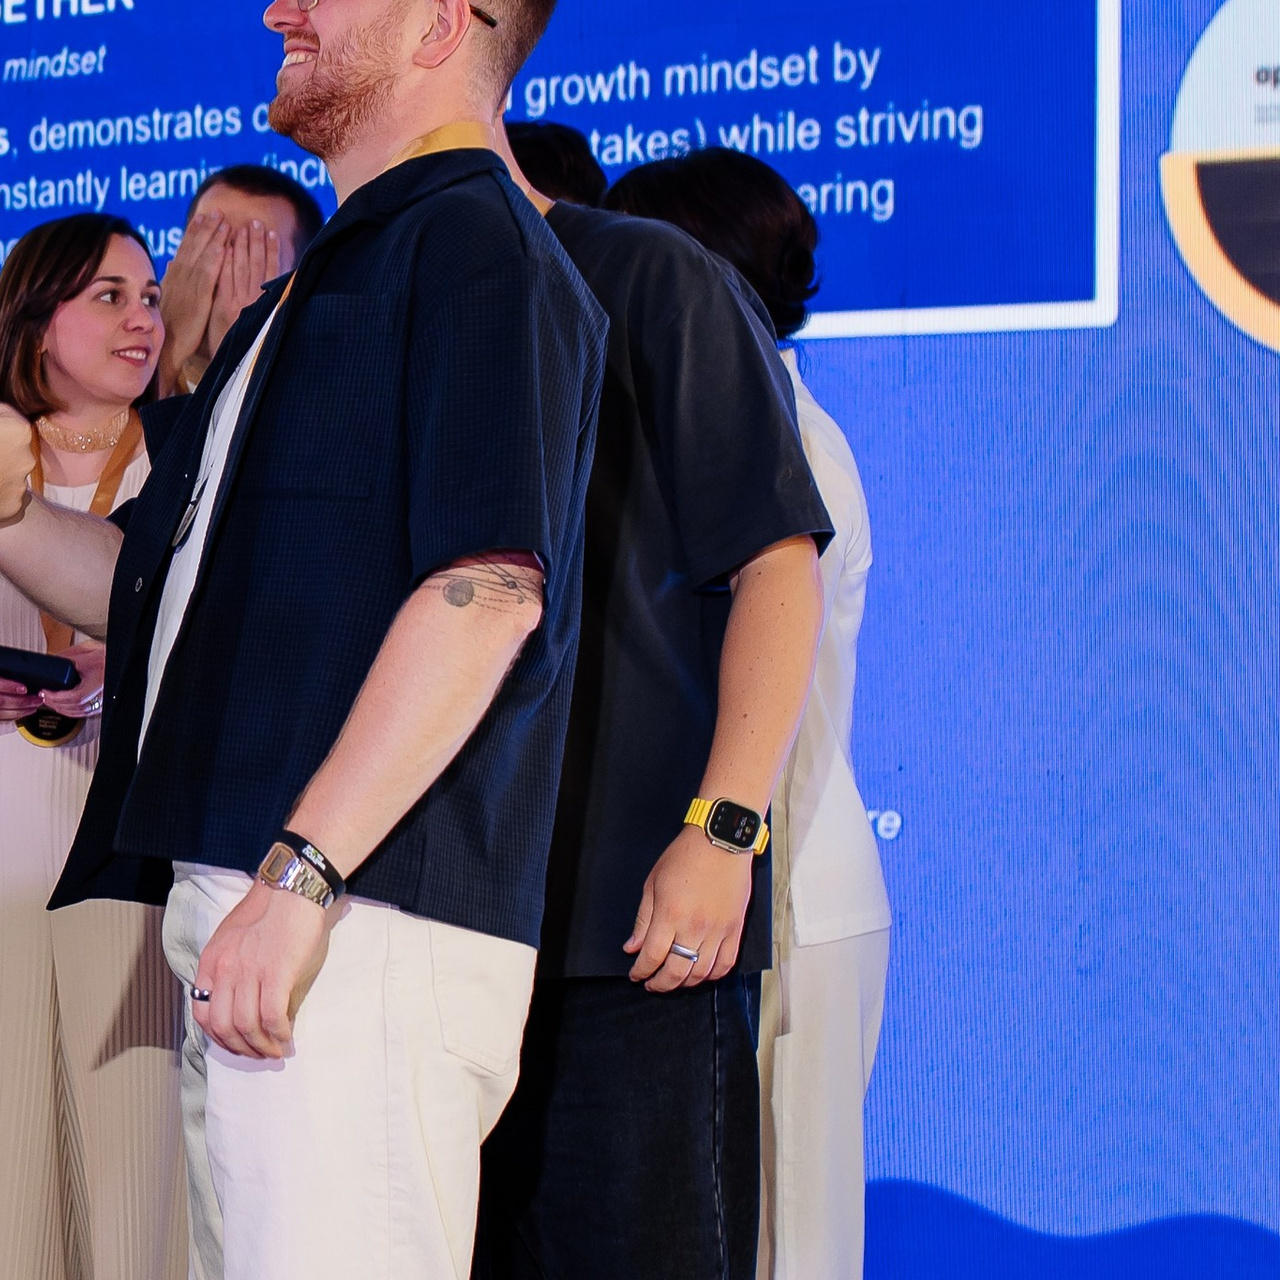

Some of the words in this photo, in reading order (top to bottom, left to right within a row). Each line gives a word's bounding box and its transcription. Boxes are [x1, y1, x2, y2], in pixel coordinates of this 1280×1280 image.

[3, 44, 107, 82] mindset
[29, 103, 241, 152] demonstrates
[524, 60, 651, 118] growth
[664, 47, 818, 97] mindset
[833, 41, 880, 90] by
[719, 110, 820, 153] while
[835, 99, 984, 150] striving
